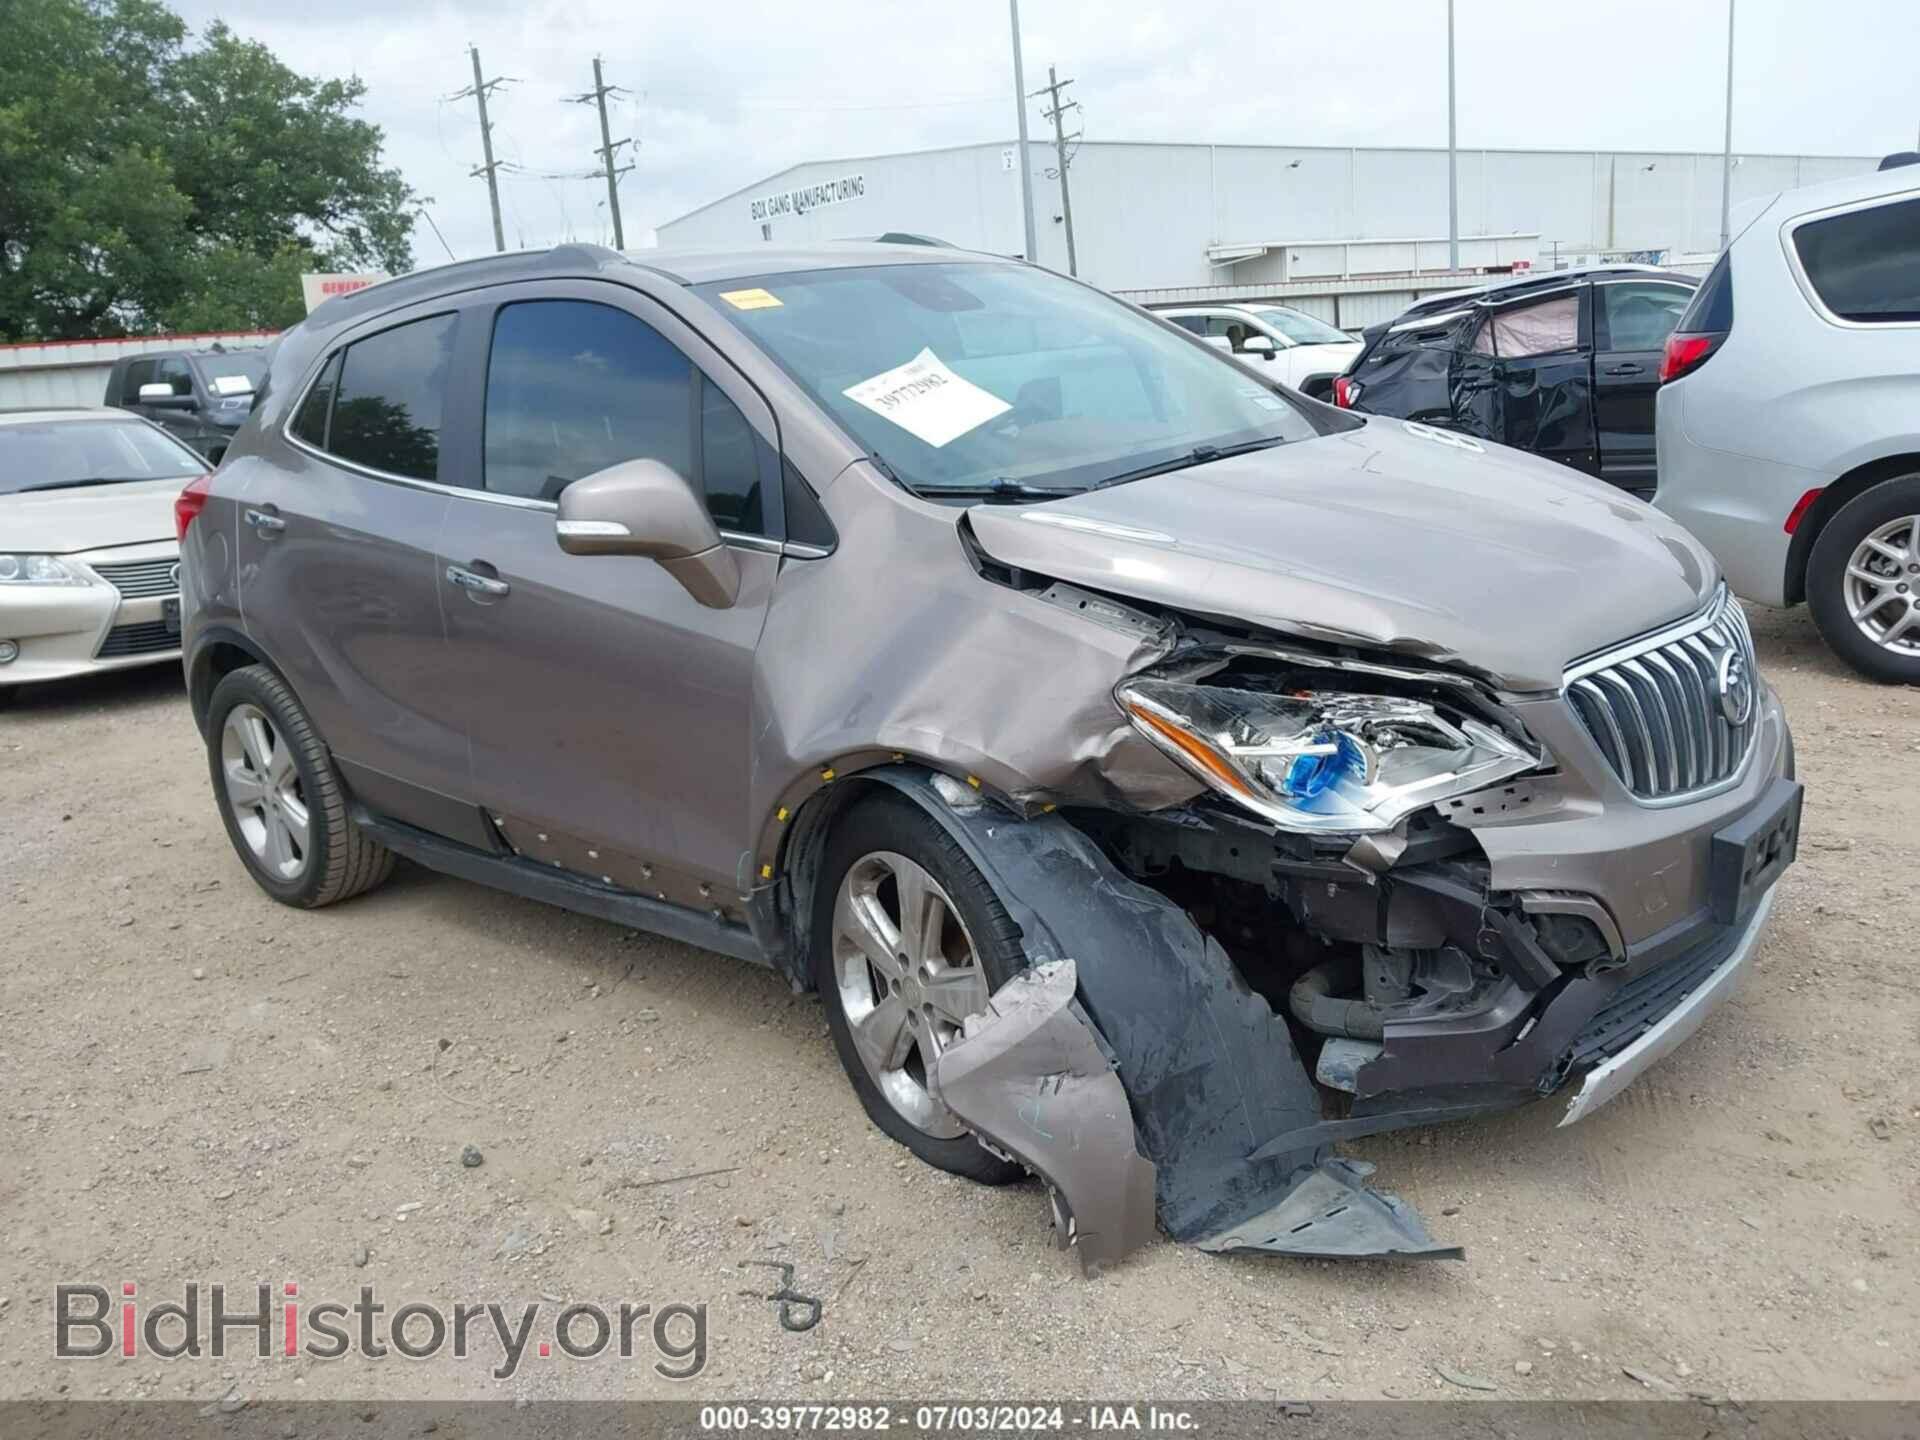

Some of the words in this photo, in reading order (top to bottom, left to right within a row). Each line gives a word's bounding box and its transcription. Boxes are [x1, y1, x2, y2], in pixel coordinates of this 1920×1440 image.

[752, 201, 767, 220] BOX
[768, 194, 791, 216] GANG
[792, 175, 864, 209] MANUFACTURING
[874, 373, 949, 411] 39772982
